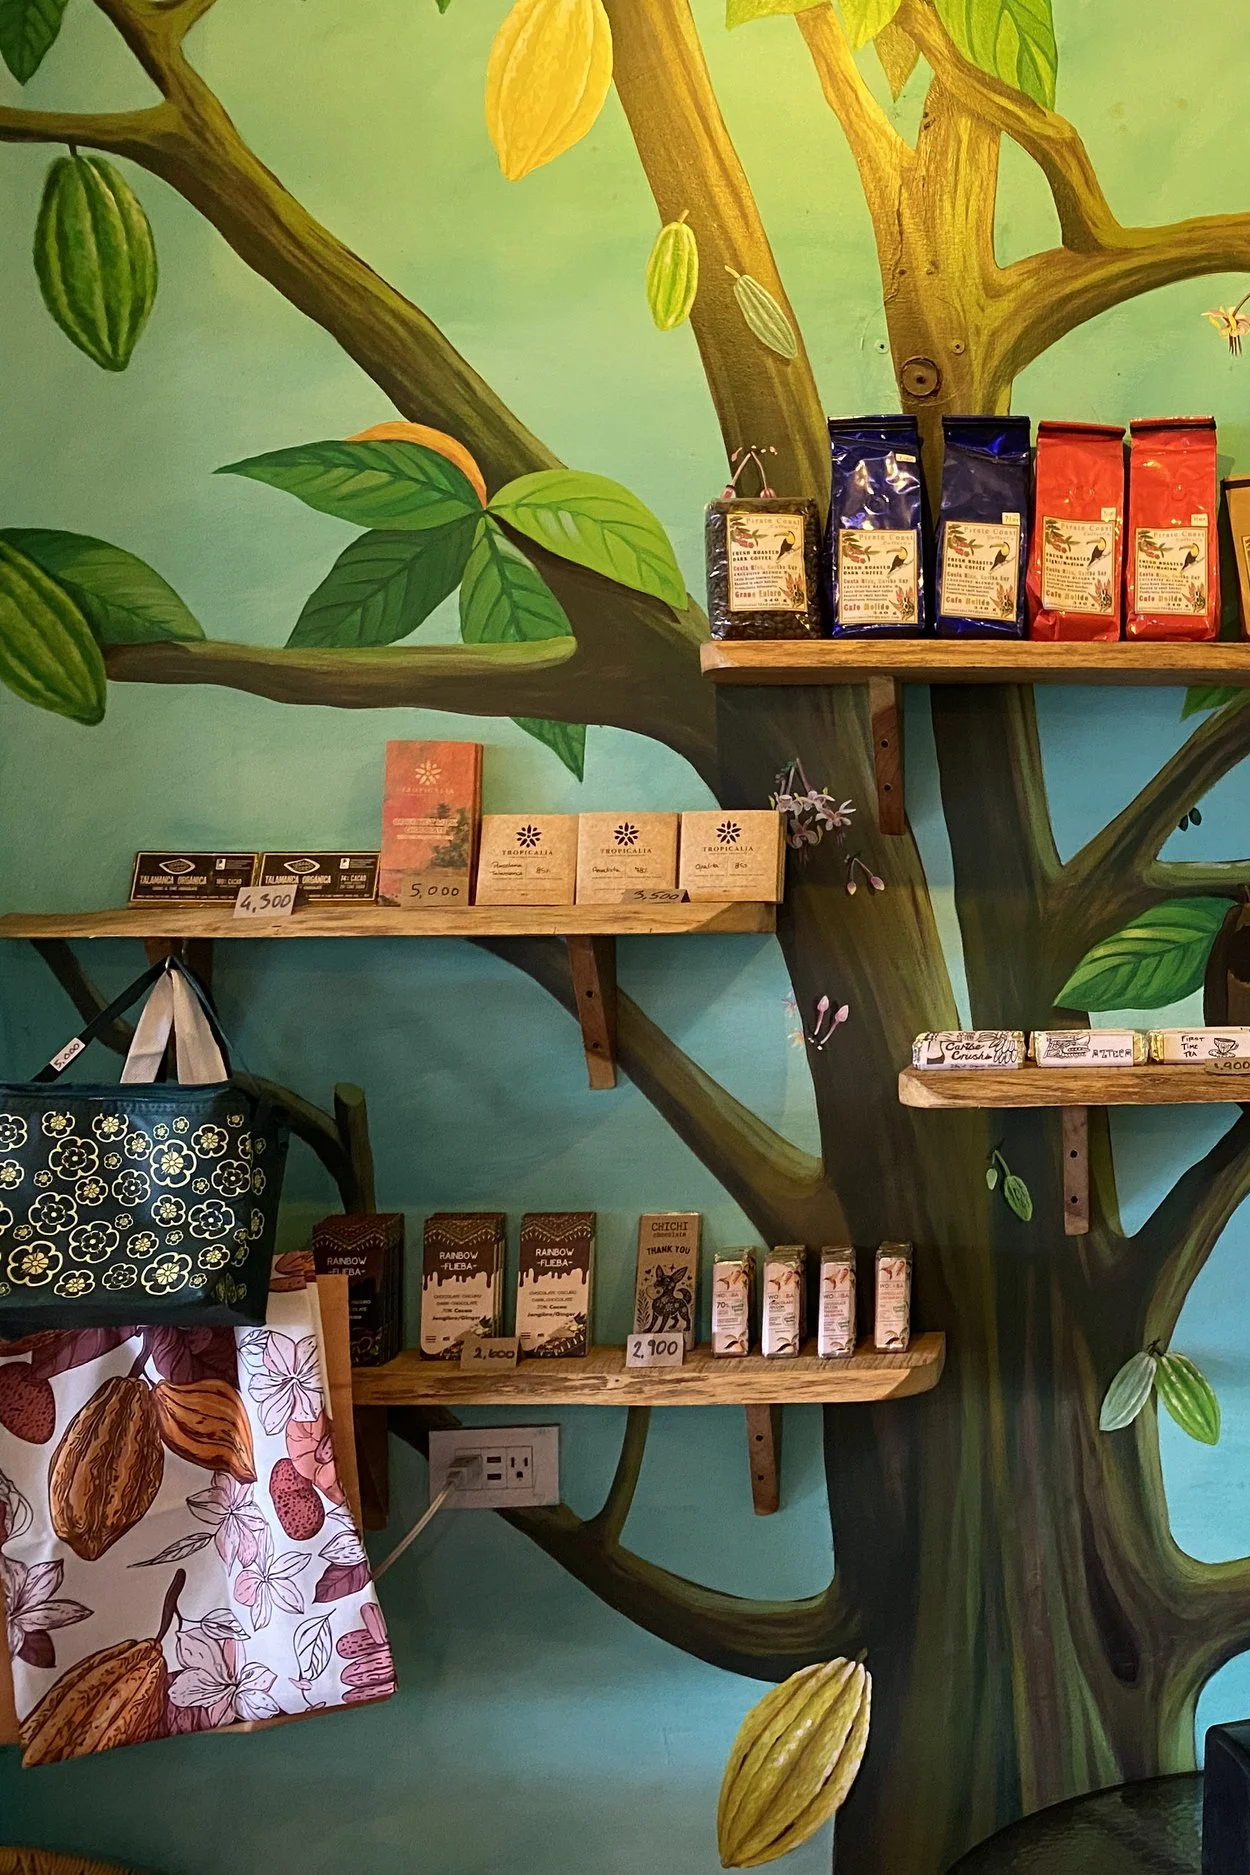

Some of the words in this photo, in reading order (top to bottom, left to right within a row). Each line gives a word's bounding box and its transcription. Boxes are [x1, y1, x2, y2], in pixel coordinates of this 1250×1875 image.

[140, 875, 174, 884] TALAMANCA
[265, 875, 299, 884] TALAMANCA
[410, 883, 459, 899] 5,000
[634, 890, 679, 900] 3,500
[945, 1042, 984, 1051] Caribe
[54, 1042, 80, 1068] 5,000
[951, 1051, 988, 1060] Crush
[1091, 1048, 1132, 1058] AZTECA
[651, 1222, 688, 1231] CHICHI
[536, 1248, 574, 1256] RAINBOW
[646, 1245, 672, 1255] THANK
[675, 1245, 690, 1255] YOU
[440, 1251, 478, 1260] RAINBOW
[327, 1256, 367, 1265] RAINBOW
